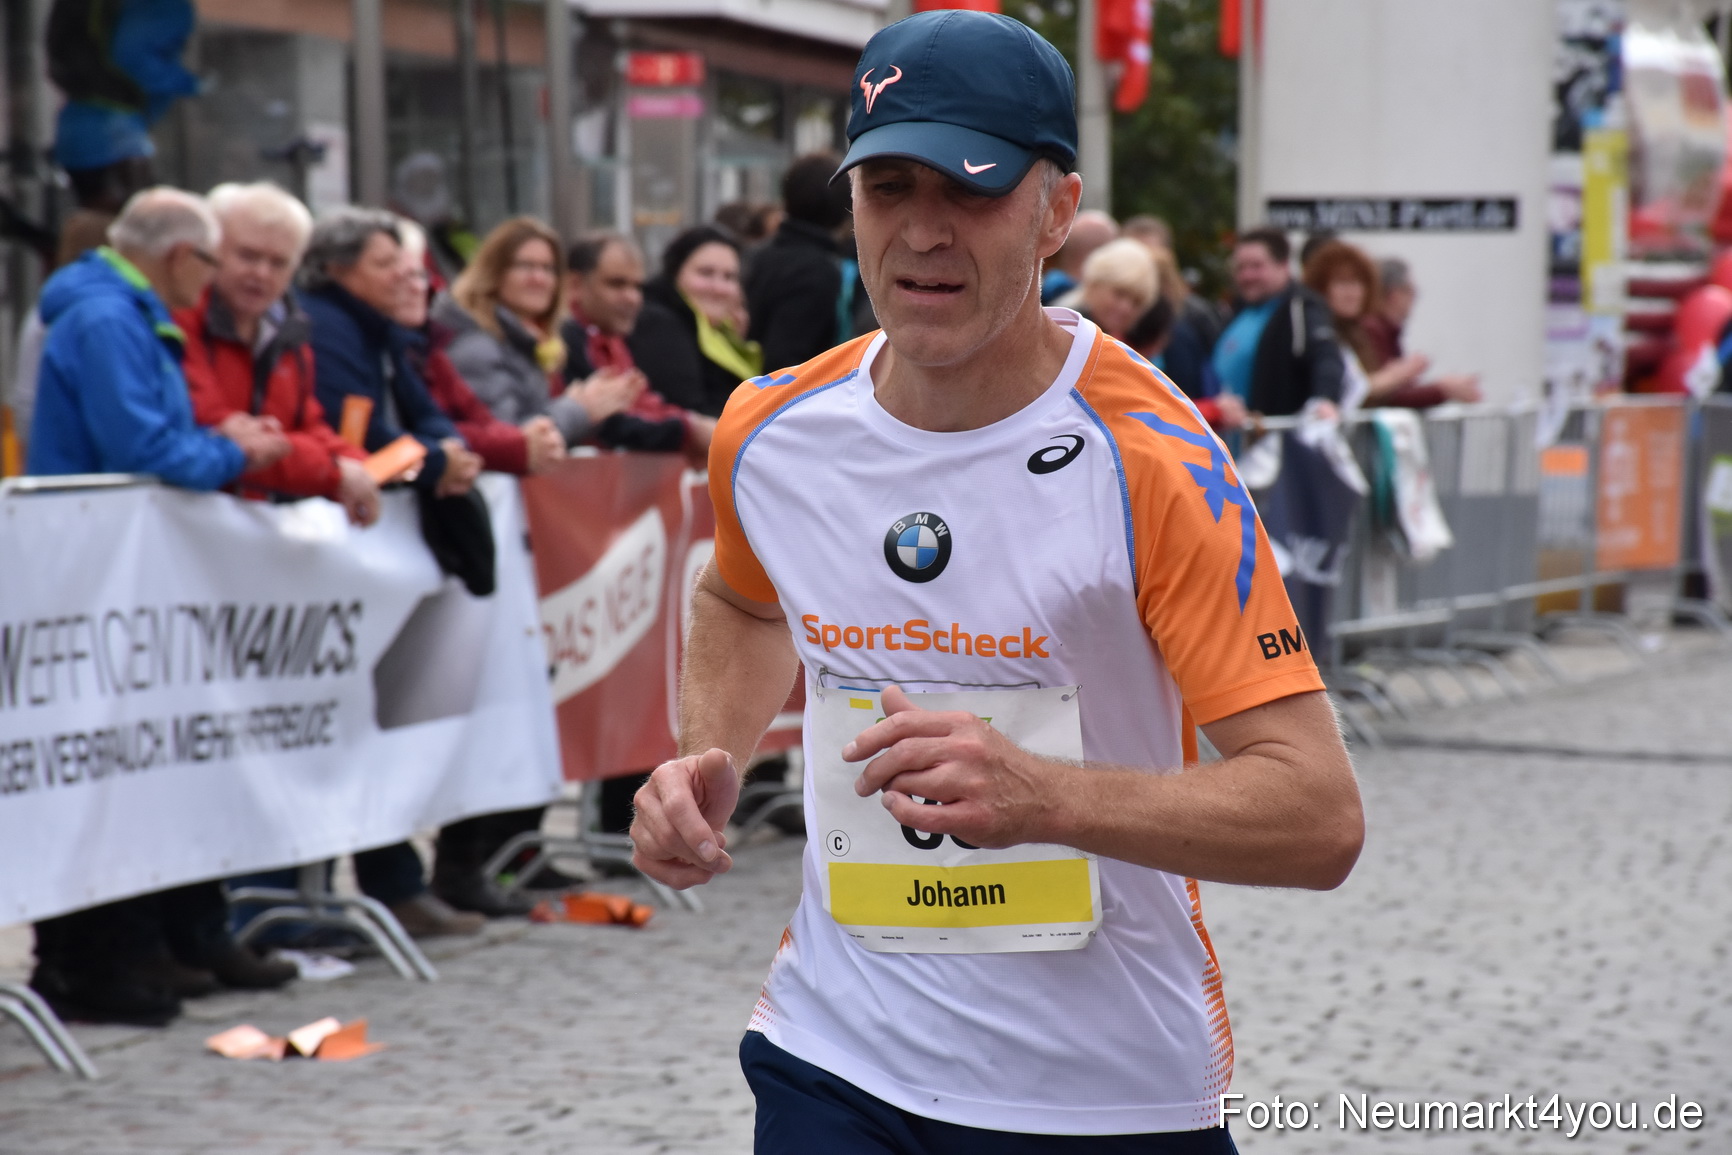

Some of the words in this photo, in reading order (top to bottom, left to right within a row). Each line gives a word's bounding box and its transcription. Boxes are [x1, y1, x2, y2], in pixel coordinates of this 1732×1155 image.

[892, 513, 948, 537] BMW
[801, 614, 1050, 659] SportScheck
[834, 836, 843, 851] C
[906, 879, 1006, 908] Johann
